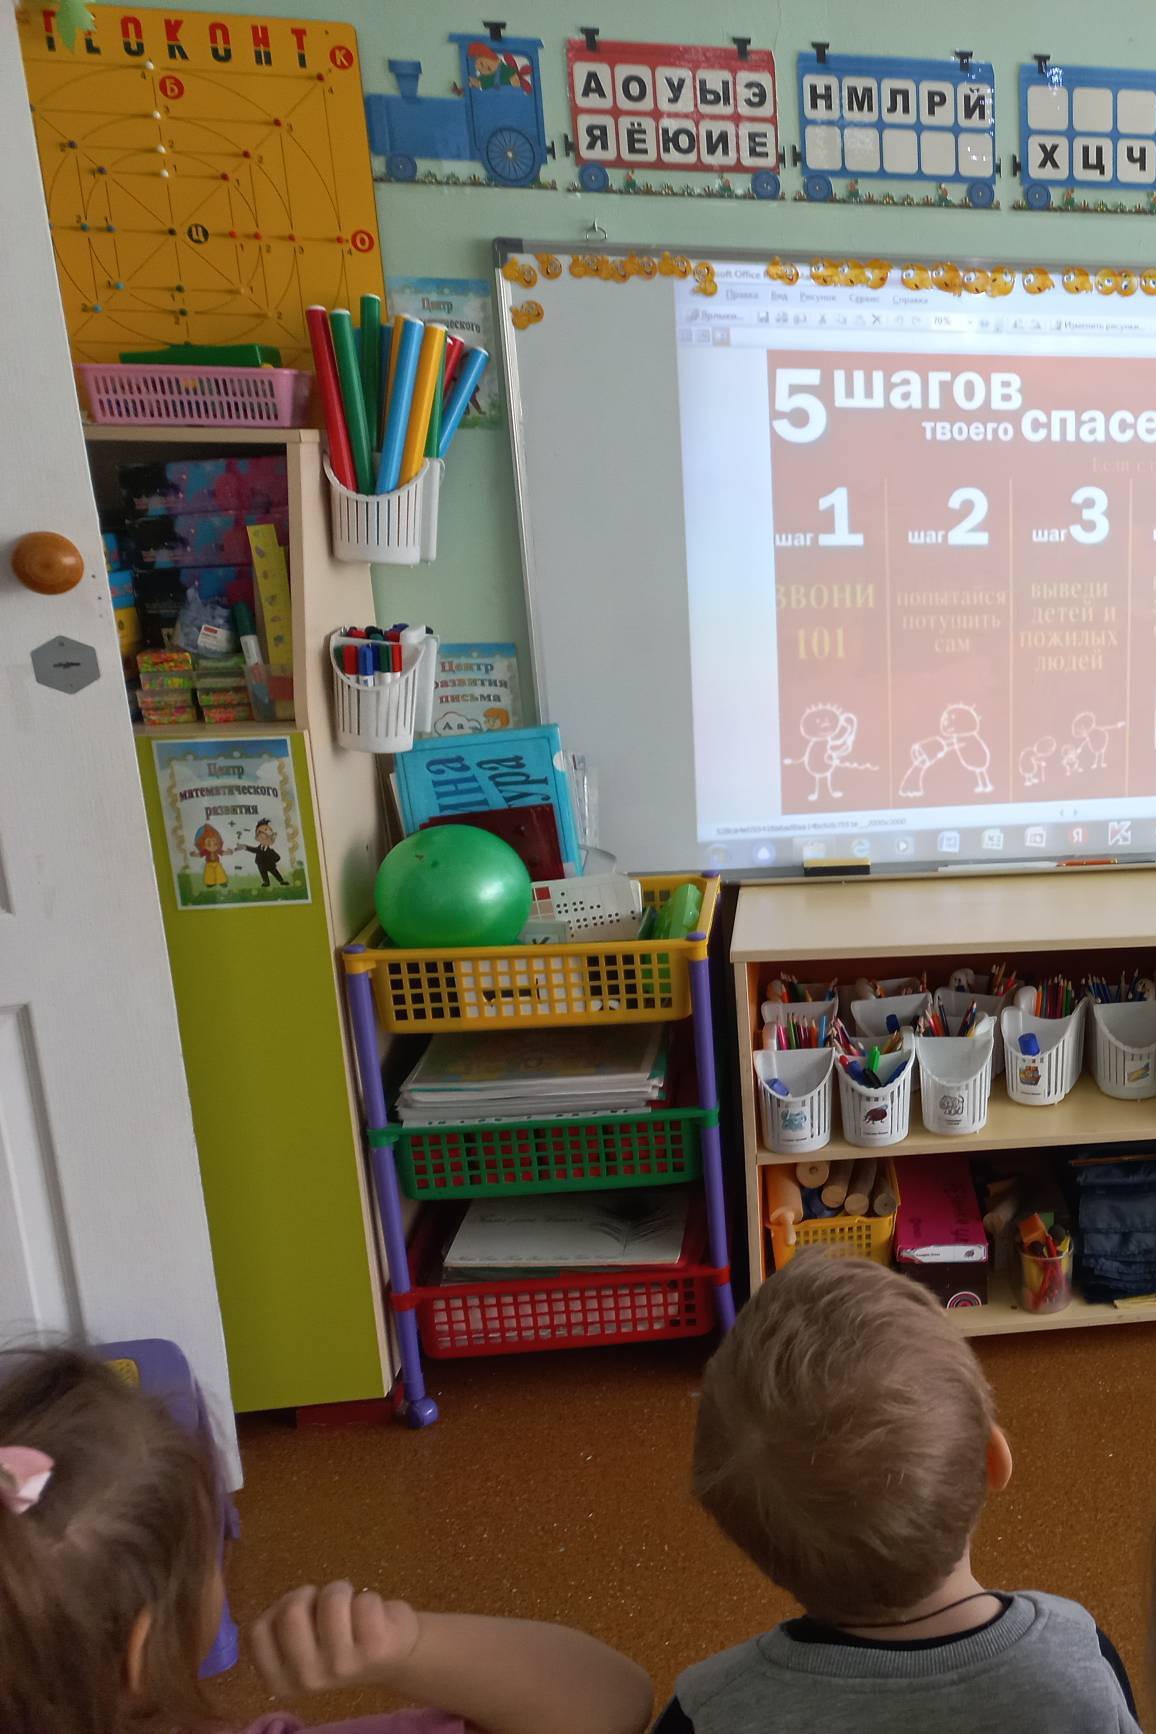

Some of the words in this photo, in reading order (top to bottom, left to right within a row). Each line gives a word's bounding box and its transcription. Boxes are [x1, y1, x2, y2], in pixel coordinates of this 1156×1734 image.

[772, 368, 827, 443] 5
[834, 370, 1022, 411] шагов
[921, 422, 1014, 441] твоего
[775, 533, 814, 546] шаг
[818, 487, 864, 546] 1
[908, 530, 945, 544] шаг
[947, 487, 989, 546] 2
[1032, 528, 1067, 542] шаг
[1069, 486, 1110, 544] 3
[896, 585, 1007, 607] попытайся
[1031, 581, 1109, 600] выведи
[1032, 599, 1094, 625] детей
[1104, 606, 1118, 623] и
[902, 614, 1002, 634] потушить
[797, 626, 846, 660] 101
[934, 638, 972, 654] сам
[1020, 629, 1119, 648] пожилых
[440, 661, 494, 675] Центр
[1035, 649, 1103, 673] людей
[440, 694, 502, 704] письма
[207, 763, 245, 779] Центр
[179, 785, 279, 803] математического
[205, 804, 259, 820] развития
